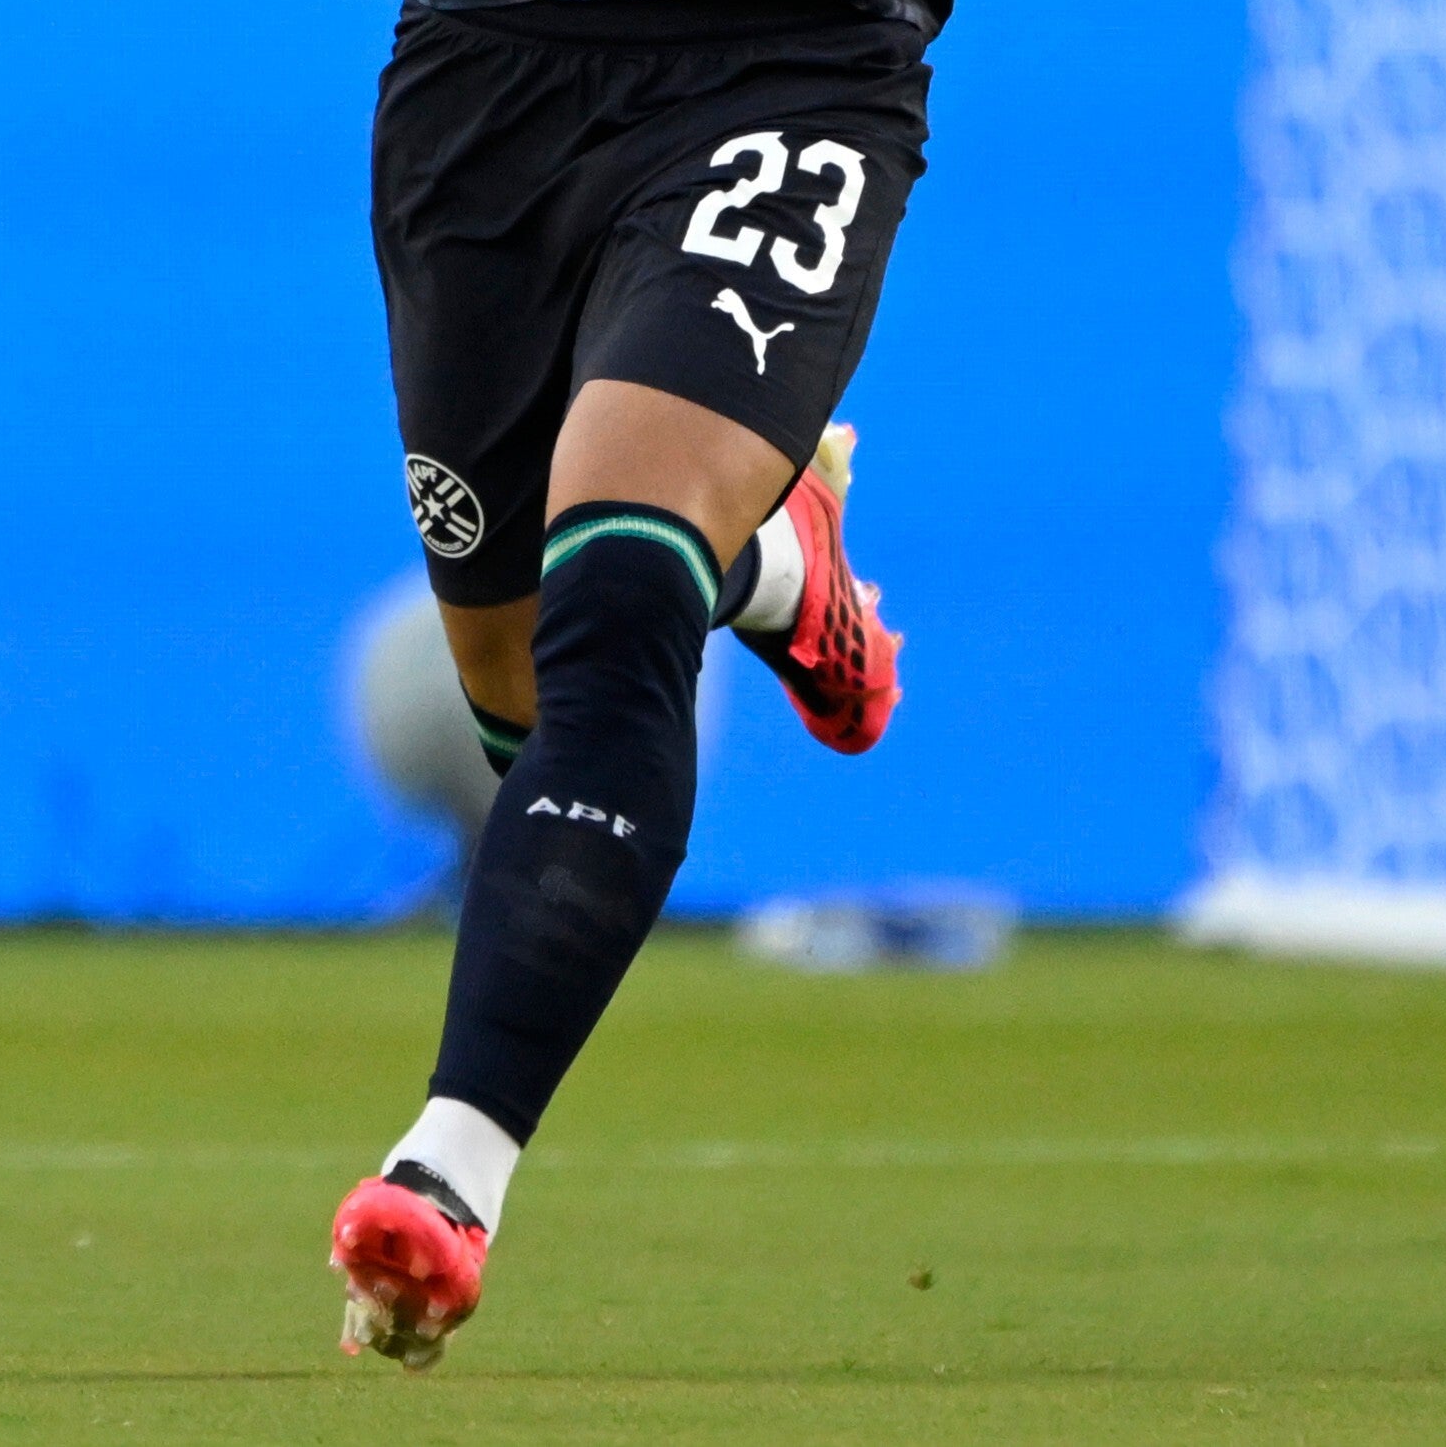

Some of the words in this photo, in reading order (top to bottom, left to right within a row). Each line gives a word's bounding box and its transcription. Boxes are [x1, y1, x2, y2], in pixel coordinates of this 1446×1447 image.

[680, 131, 867, 295] 23
[413, 462, 438, 483] APF
[526, 796, 637, 838] APF
